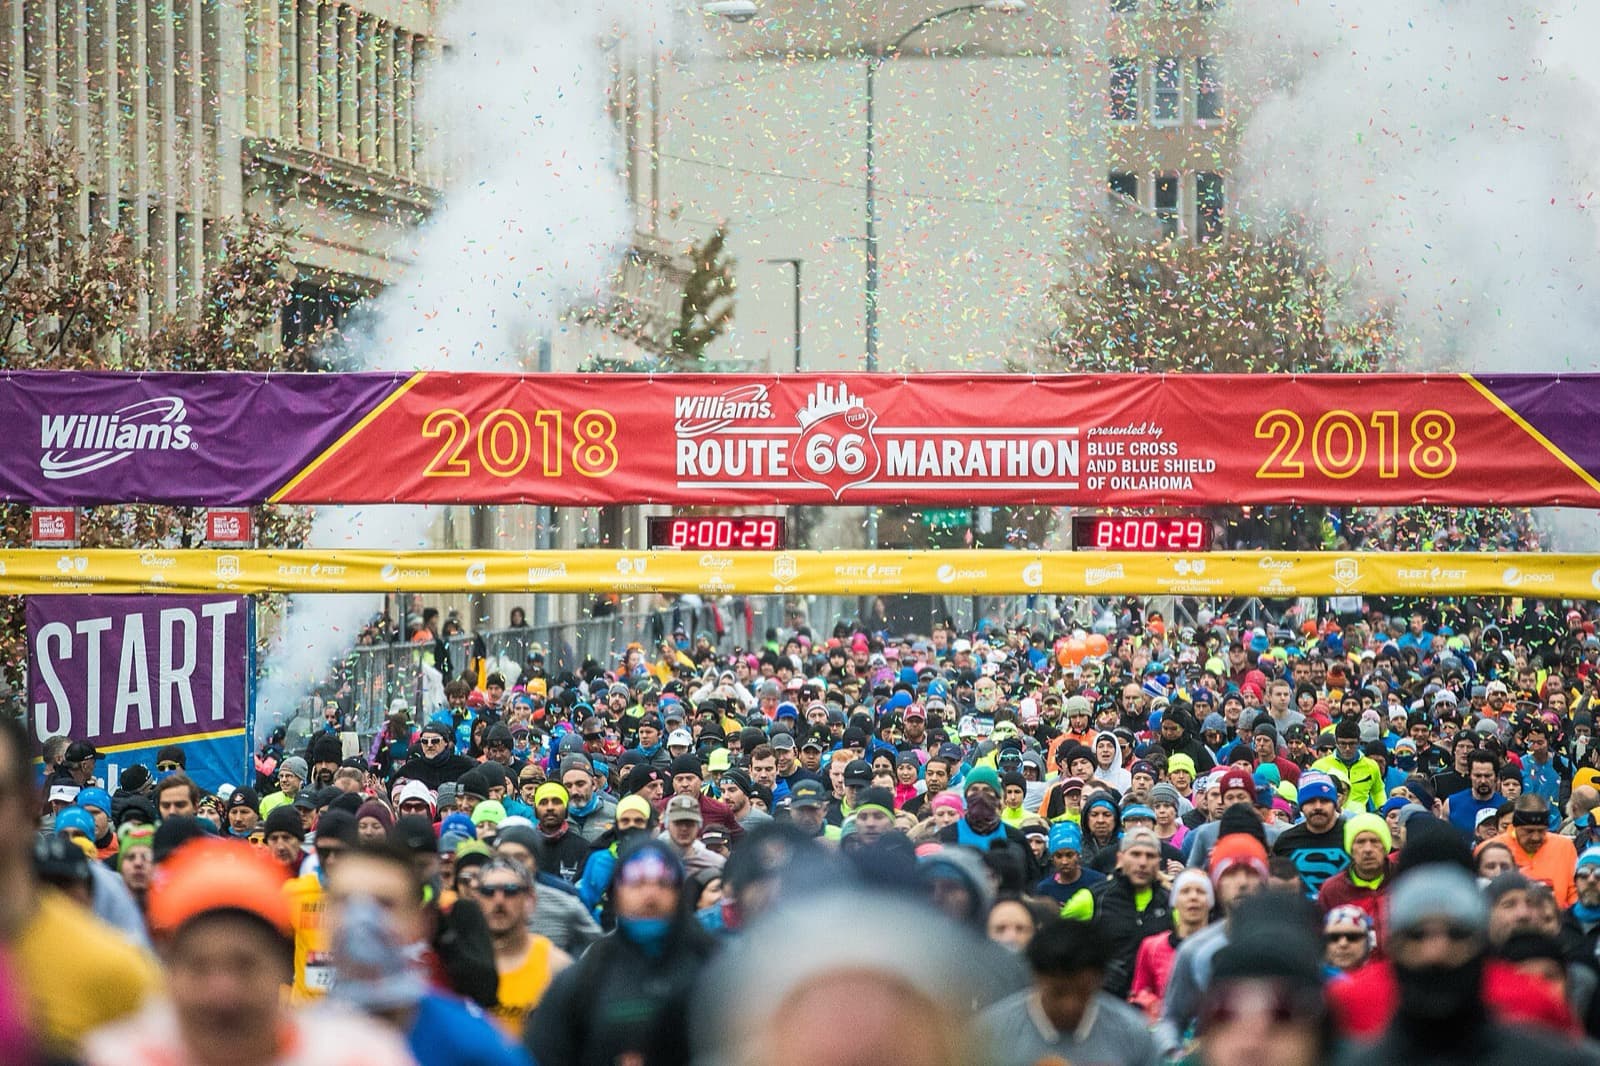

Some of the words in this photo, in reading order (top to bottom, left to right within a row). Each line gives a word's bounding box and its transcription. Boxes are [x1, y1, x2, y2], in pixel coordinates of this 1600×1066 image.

[675, 396, 772, 419] Williams
[847, 413, 866, 423] TULSA
[41, 415, 193, 450] Williams
[1087, 422, 1146, 439] presented
[1148, 422, 1163, 439] by
[422, 408, 619, 477] 2018
[1087, 442, 1125, 456] BLUE
[1129, 442, 1178, 456] CROSS
[1255, 409, 1458, 479] 2018
[676, 439, 789, 476] ROUTE
[806, 433, 866, 474] 66
[886, 439, 1080, 477] MARATHON
[1087, 459, 1117, 473] AND
[1121, 459, 1160, 473] BLUE
[1163, 459, 1216, 473] SHIELD
[1087, 476, 1107, 490] OF
[1110, 476, 1193, 490] OKLAHOMA
[278, 565, 307, 575] FLEET
[321, 565, 347, 574] FEET
[400, 568, 430, 578] pepsi
[834, 565, 865, 575] FLEET
[878, 565, 903, 575] FEET
[957, 569, 988, 579] pepsi
[1397, 569, 1428, 579] FLEET
[1441, 569, 1468, 579] FEET
[1523, 572, 1555, 584] pepsi
[34, 600, 238, 744] START
